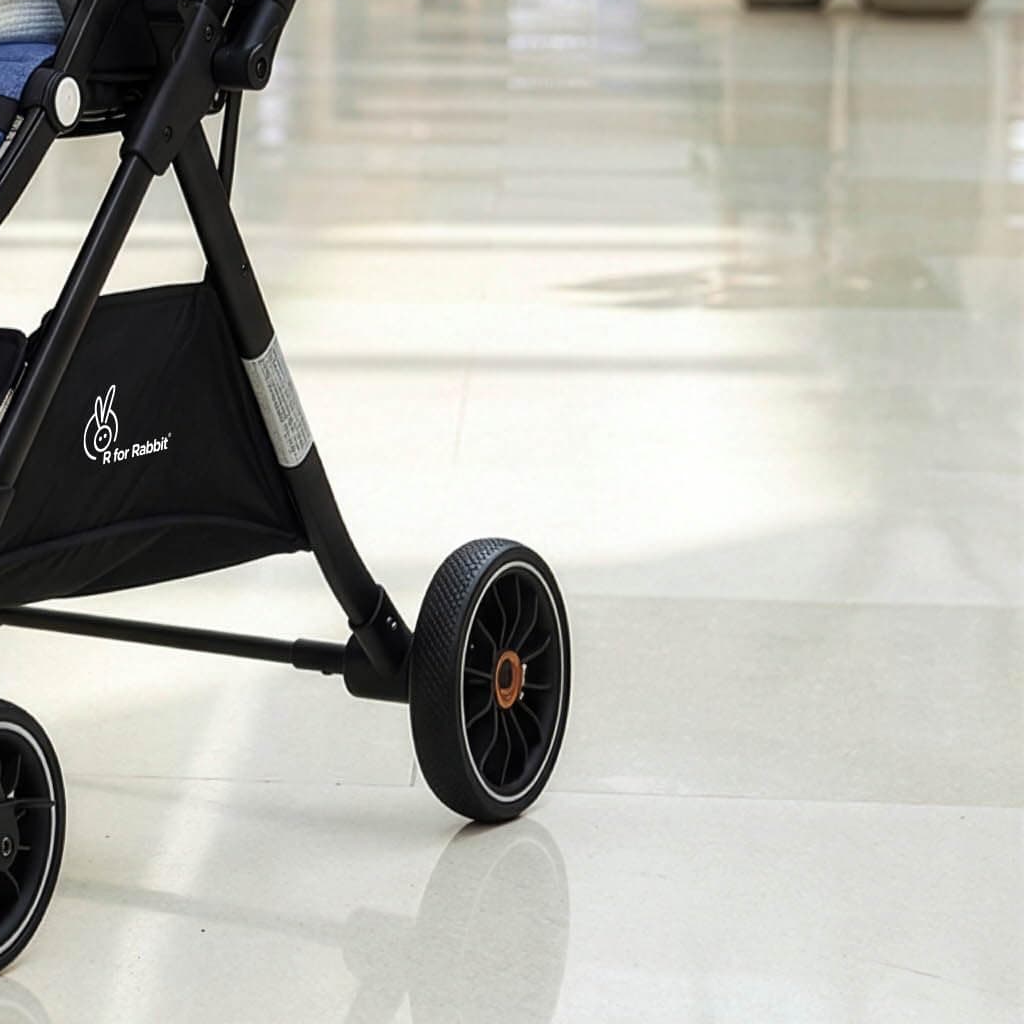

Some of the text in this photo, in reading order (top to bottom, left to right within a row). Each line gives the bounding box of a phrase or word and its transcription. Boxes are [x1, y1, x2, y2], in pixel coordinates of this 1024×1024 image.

[102, 436, 169, 465] R for Rabbit
